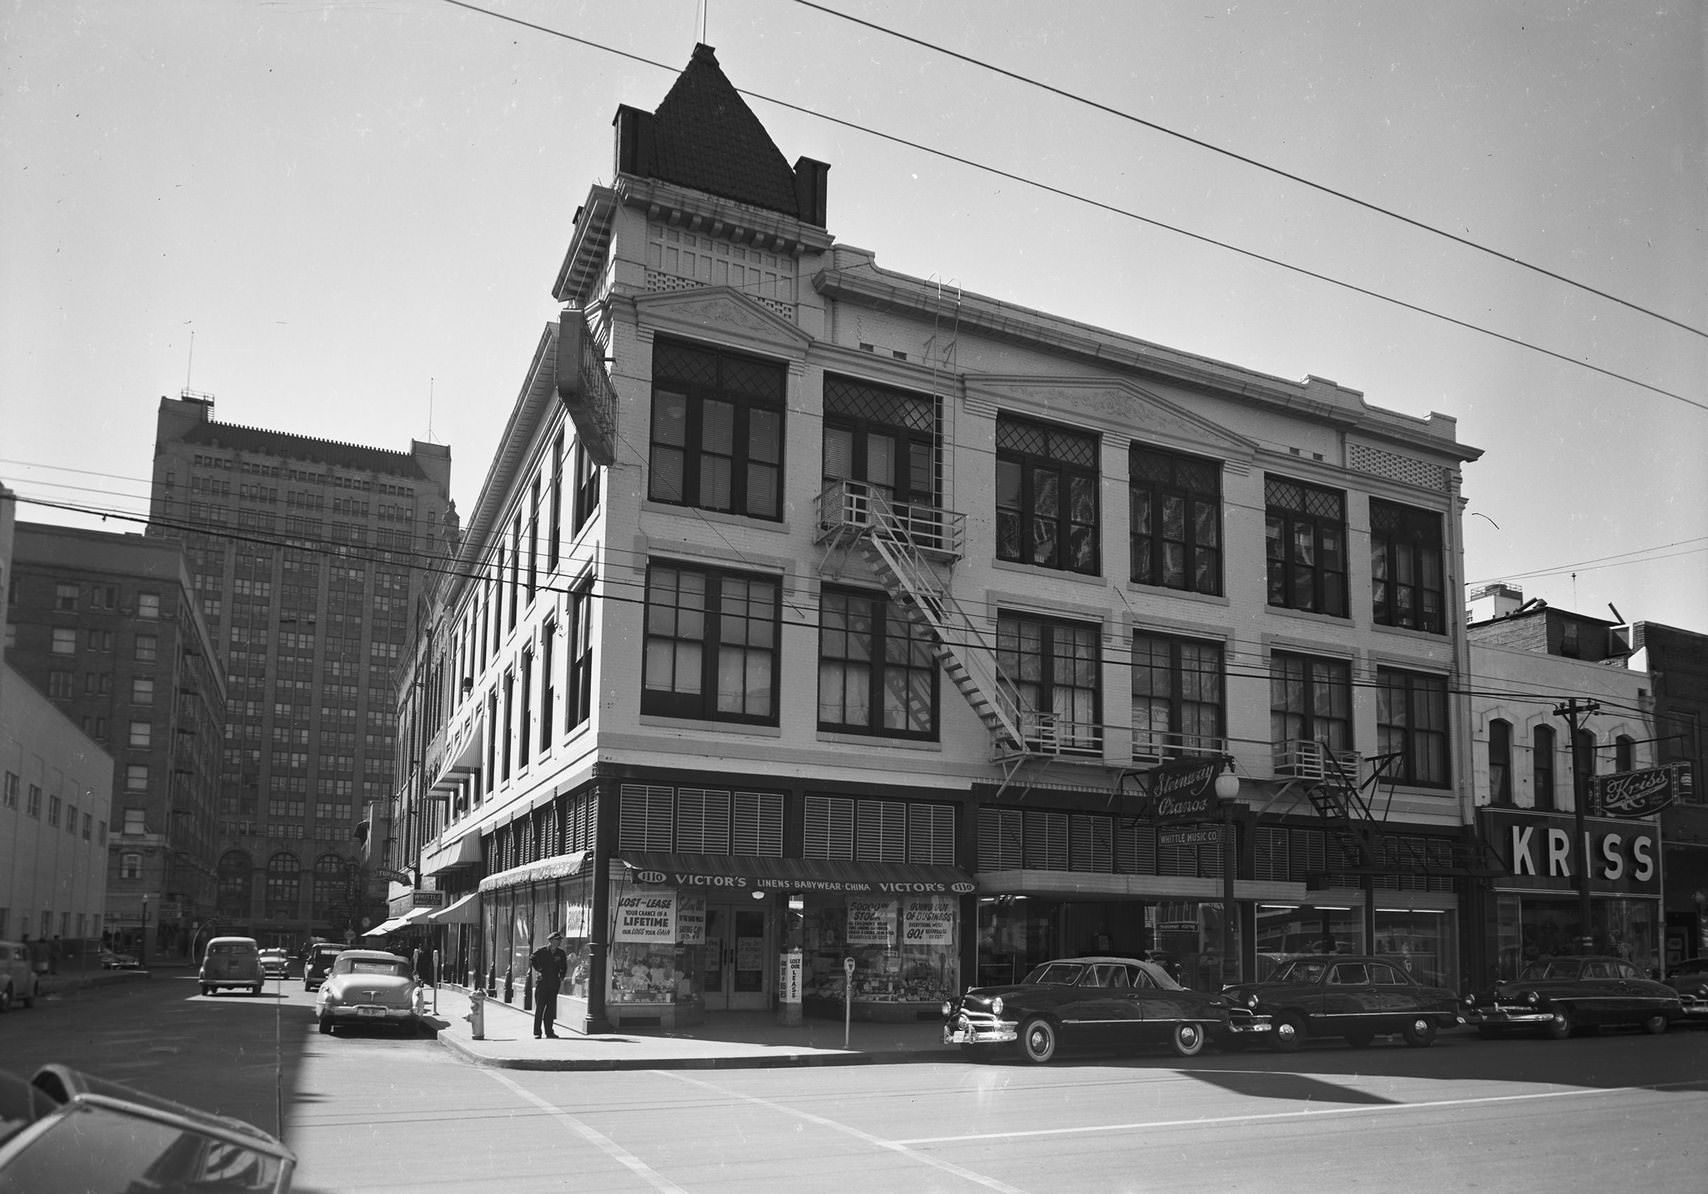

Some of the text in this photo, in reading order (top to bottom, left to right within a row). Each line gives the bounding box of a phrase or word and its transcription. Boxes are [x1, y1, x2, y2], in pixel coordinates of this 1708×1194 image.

[1153, 765, 1214, 797] Steinway
[1605, 771, 1667, 808] Kriss
[1160, 833, 1186, 843] WHITTLE
[1187, 832, 1206, 842] MUSIC
[1511, 825, 1654, 882] KRISS
[675, 874, 747, 887] VICTOR'S
[879, 882, 945, 892] VICTOR'S
[623, 917, 669, 927] LIFETIME
[906, 912, 916, 921] OF
[907, 928, 925, 940] GO!
